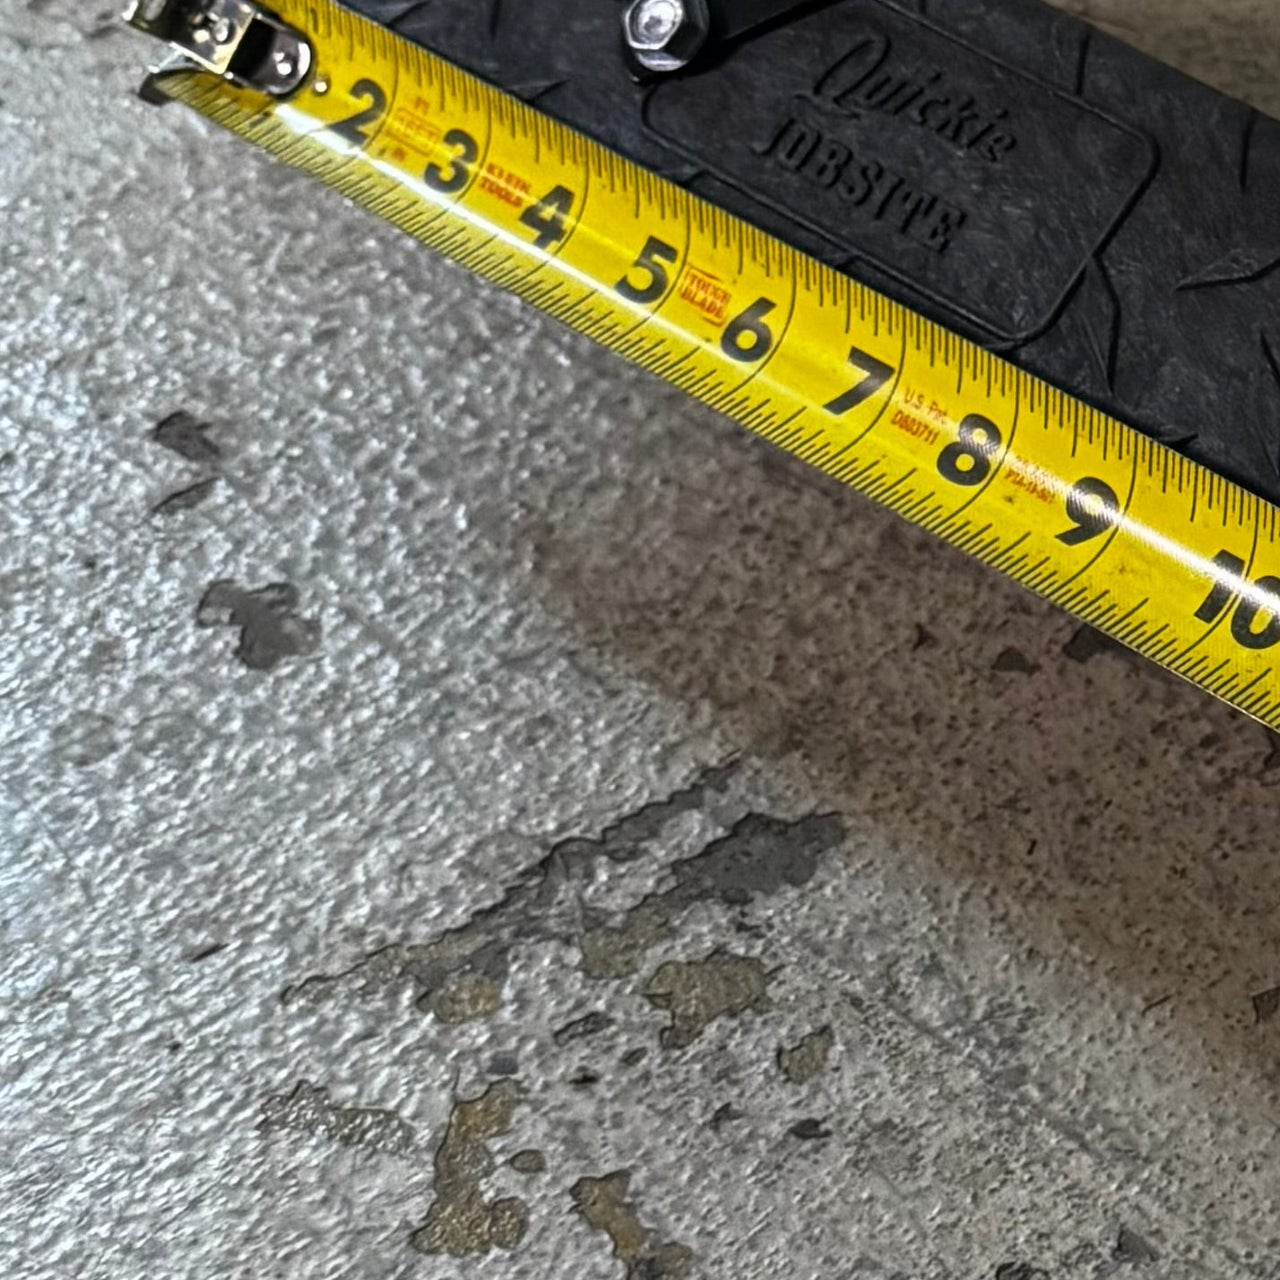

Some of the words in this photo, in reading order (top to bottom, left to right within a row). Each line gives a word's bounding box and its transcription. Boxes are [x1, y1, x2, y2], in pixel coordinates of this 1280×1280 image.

[326, 79, 387, 147] 2
[794, 35, 1017, 162] Quickie
[424, 129, 478, 194] 3
[750, 118, 968, 253] JOBSITE
[518, 185, 575, 250] 4
[614, 236, 679, 304] 5
[720, 297, 777, 363] 6
[823, 346, 896, 416] 7
[936, 413, 1002, 486] 8
[1053, 476, 1121, 546] 9
